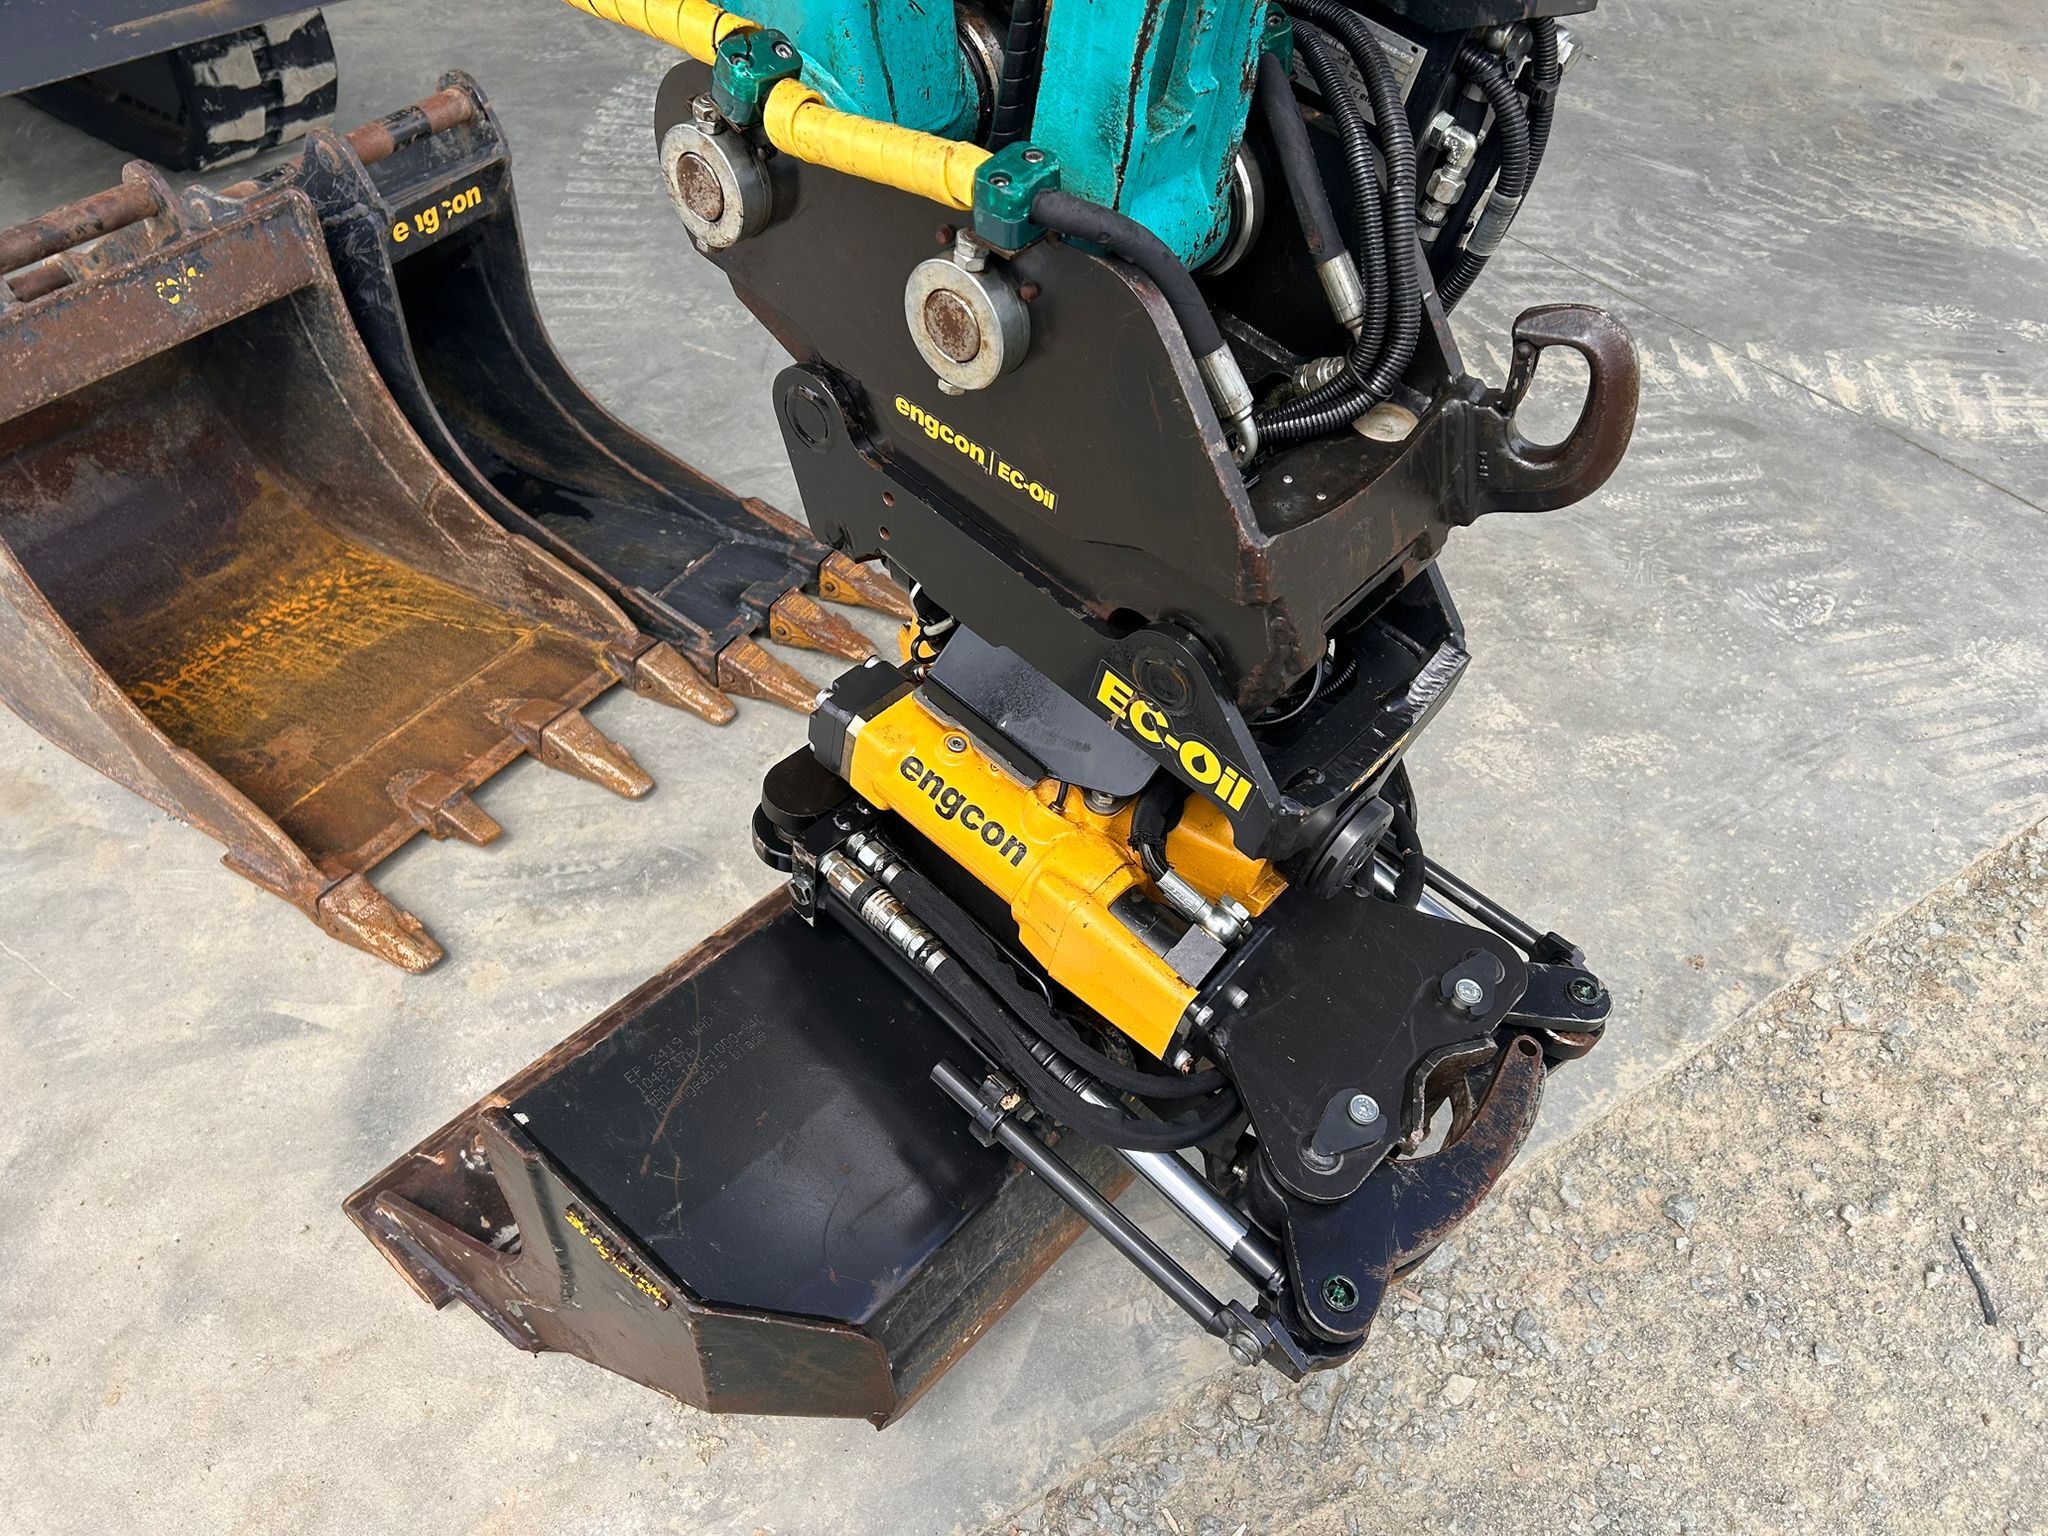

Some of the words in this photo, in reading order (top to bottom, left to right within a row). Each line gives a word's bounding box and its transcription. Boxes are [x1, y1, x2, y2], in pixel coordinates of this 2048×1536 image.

[895, 396, 986, 466] engcon
[997, 460, 1055, 511] EC-Oil
[1096, 669, 1253, 812] EC-Oil
[899, 755, 1028, 868] engcon
